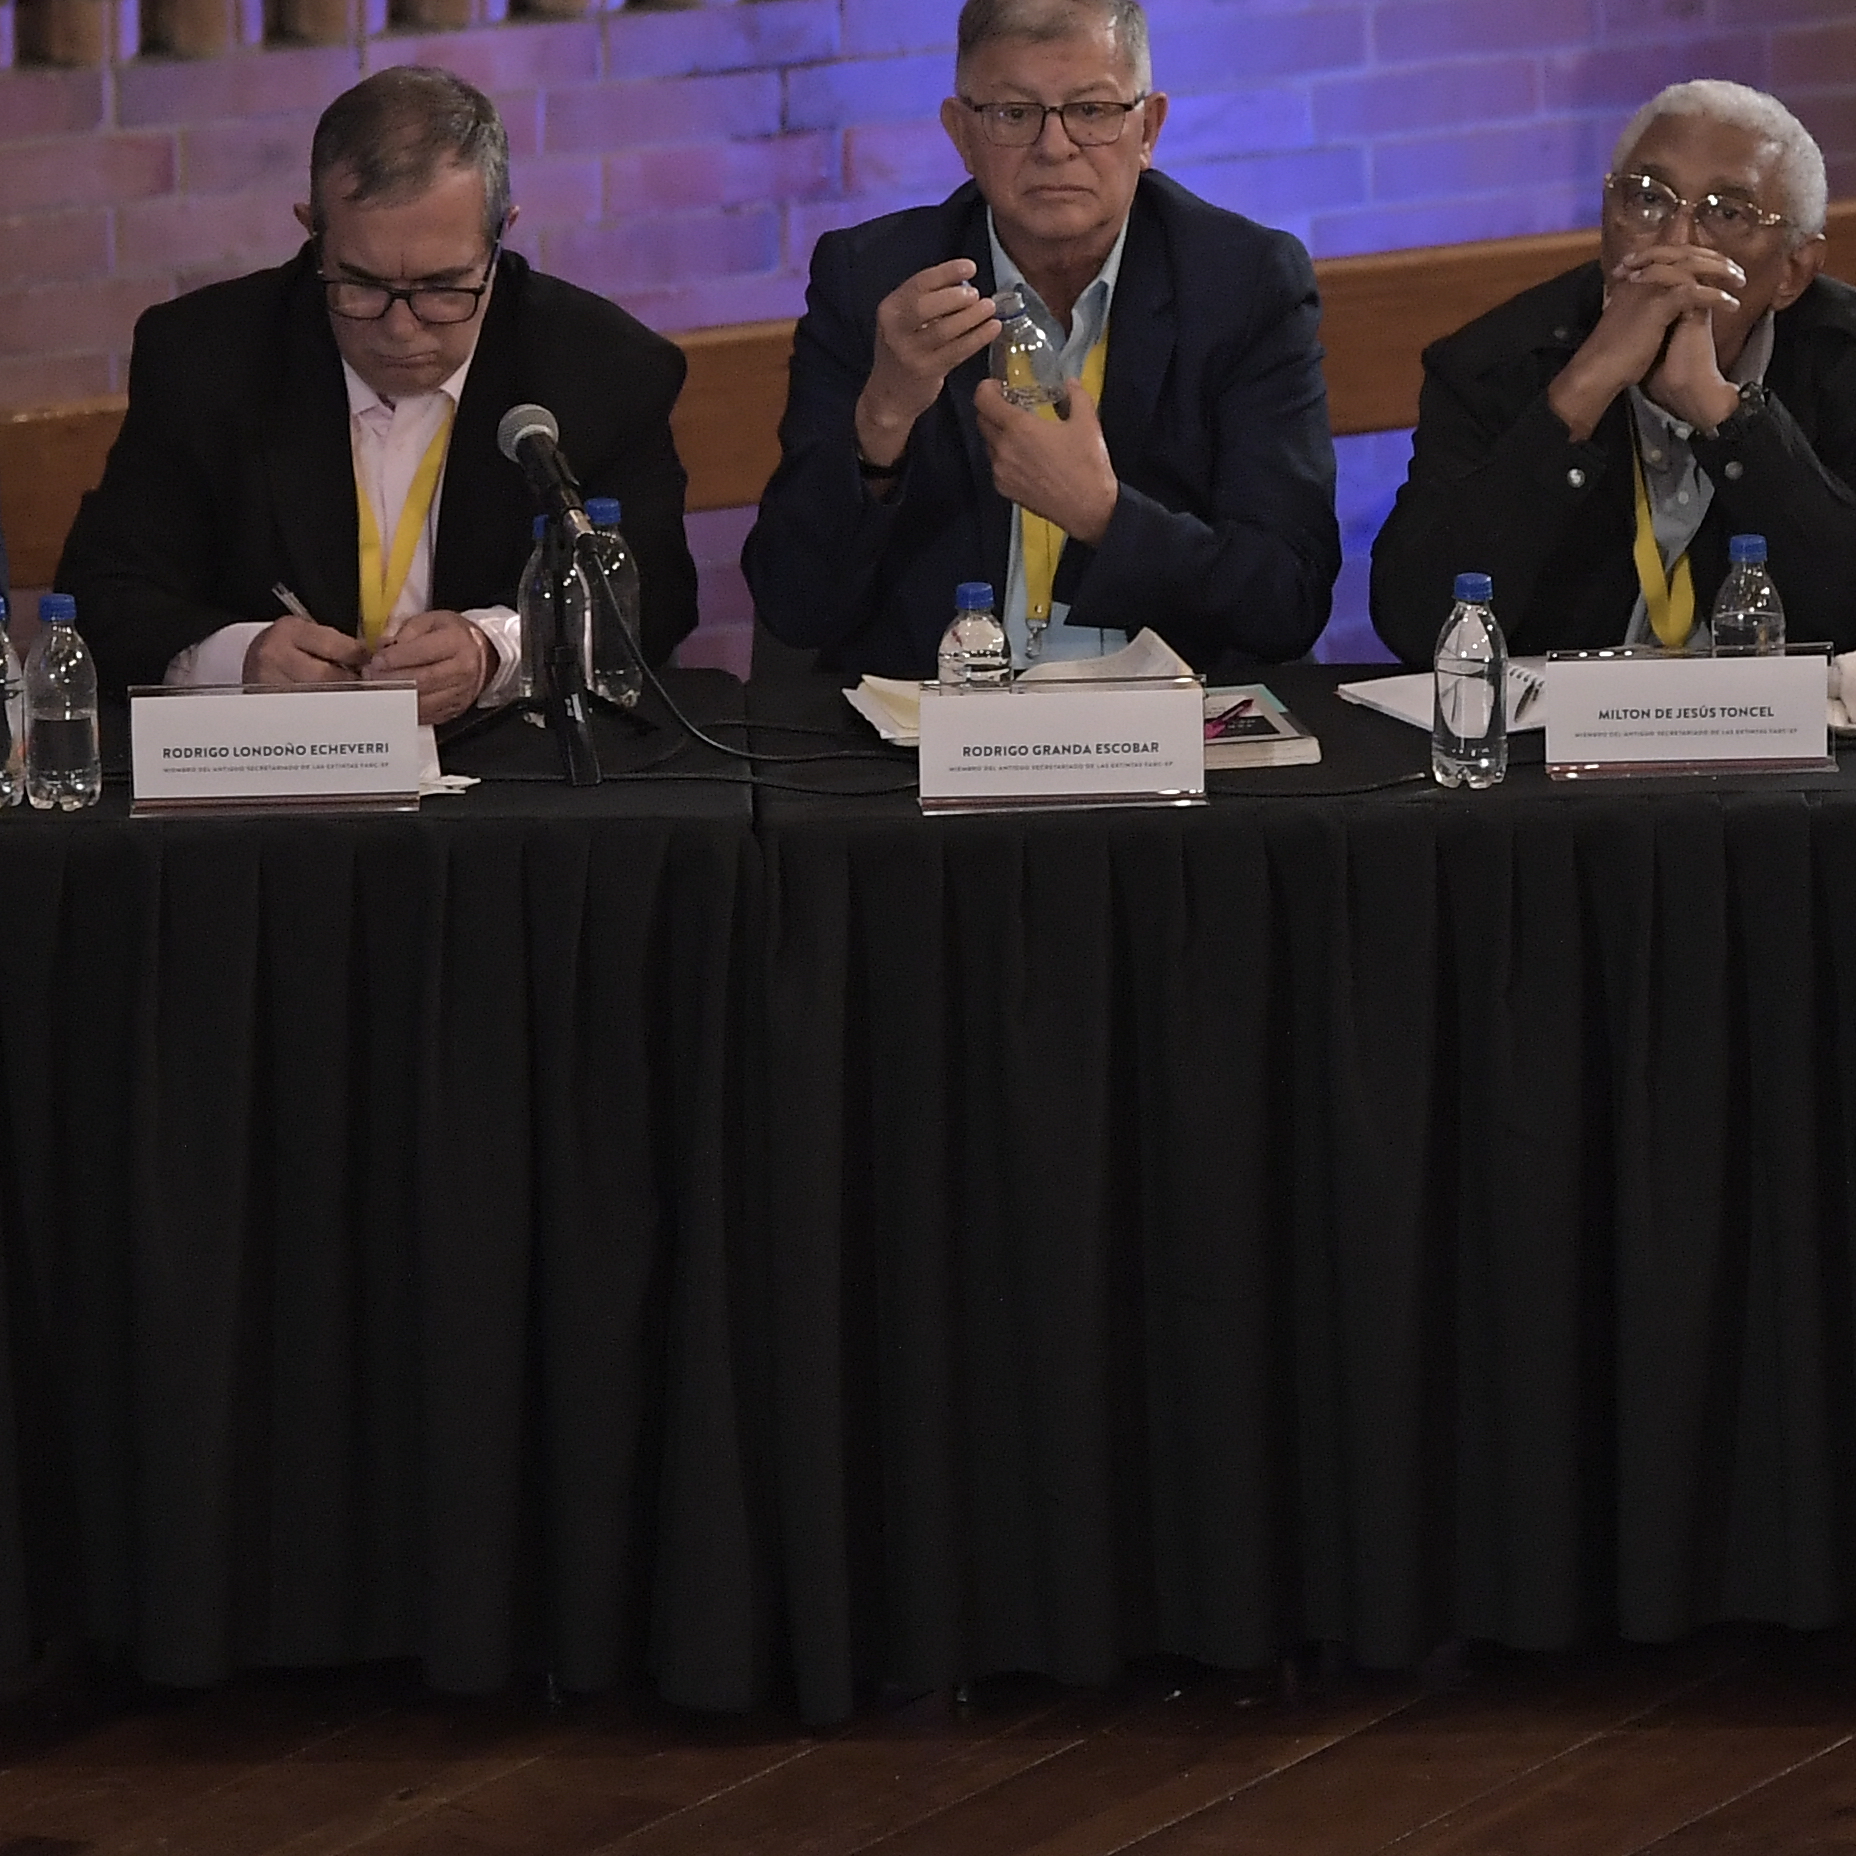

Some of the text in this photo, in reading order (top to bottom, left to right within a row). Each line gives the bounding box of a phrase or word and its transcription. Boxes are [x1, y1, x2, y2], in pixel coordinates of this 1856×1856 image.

[1598, 704, 1774, 720] MILTON DE JESÚS TONCEL
[162, 741, 388, 759] RODRIGO LONDOÑO ECHEVERRI
[962, 741, 1158, 757] RODRIGO GRANDA ESCOBAR
